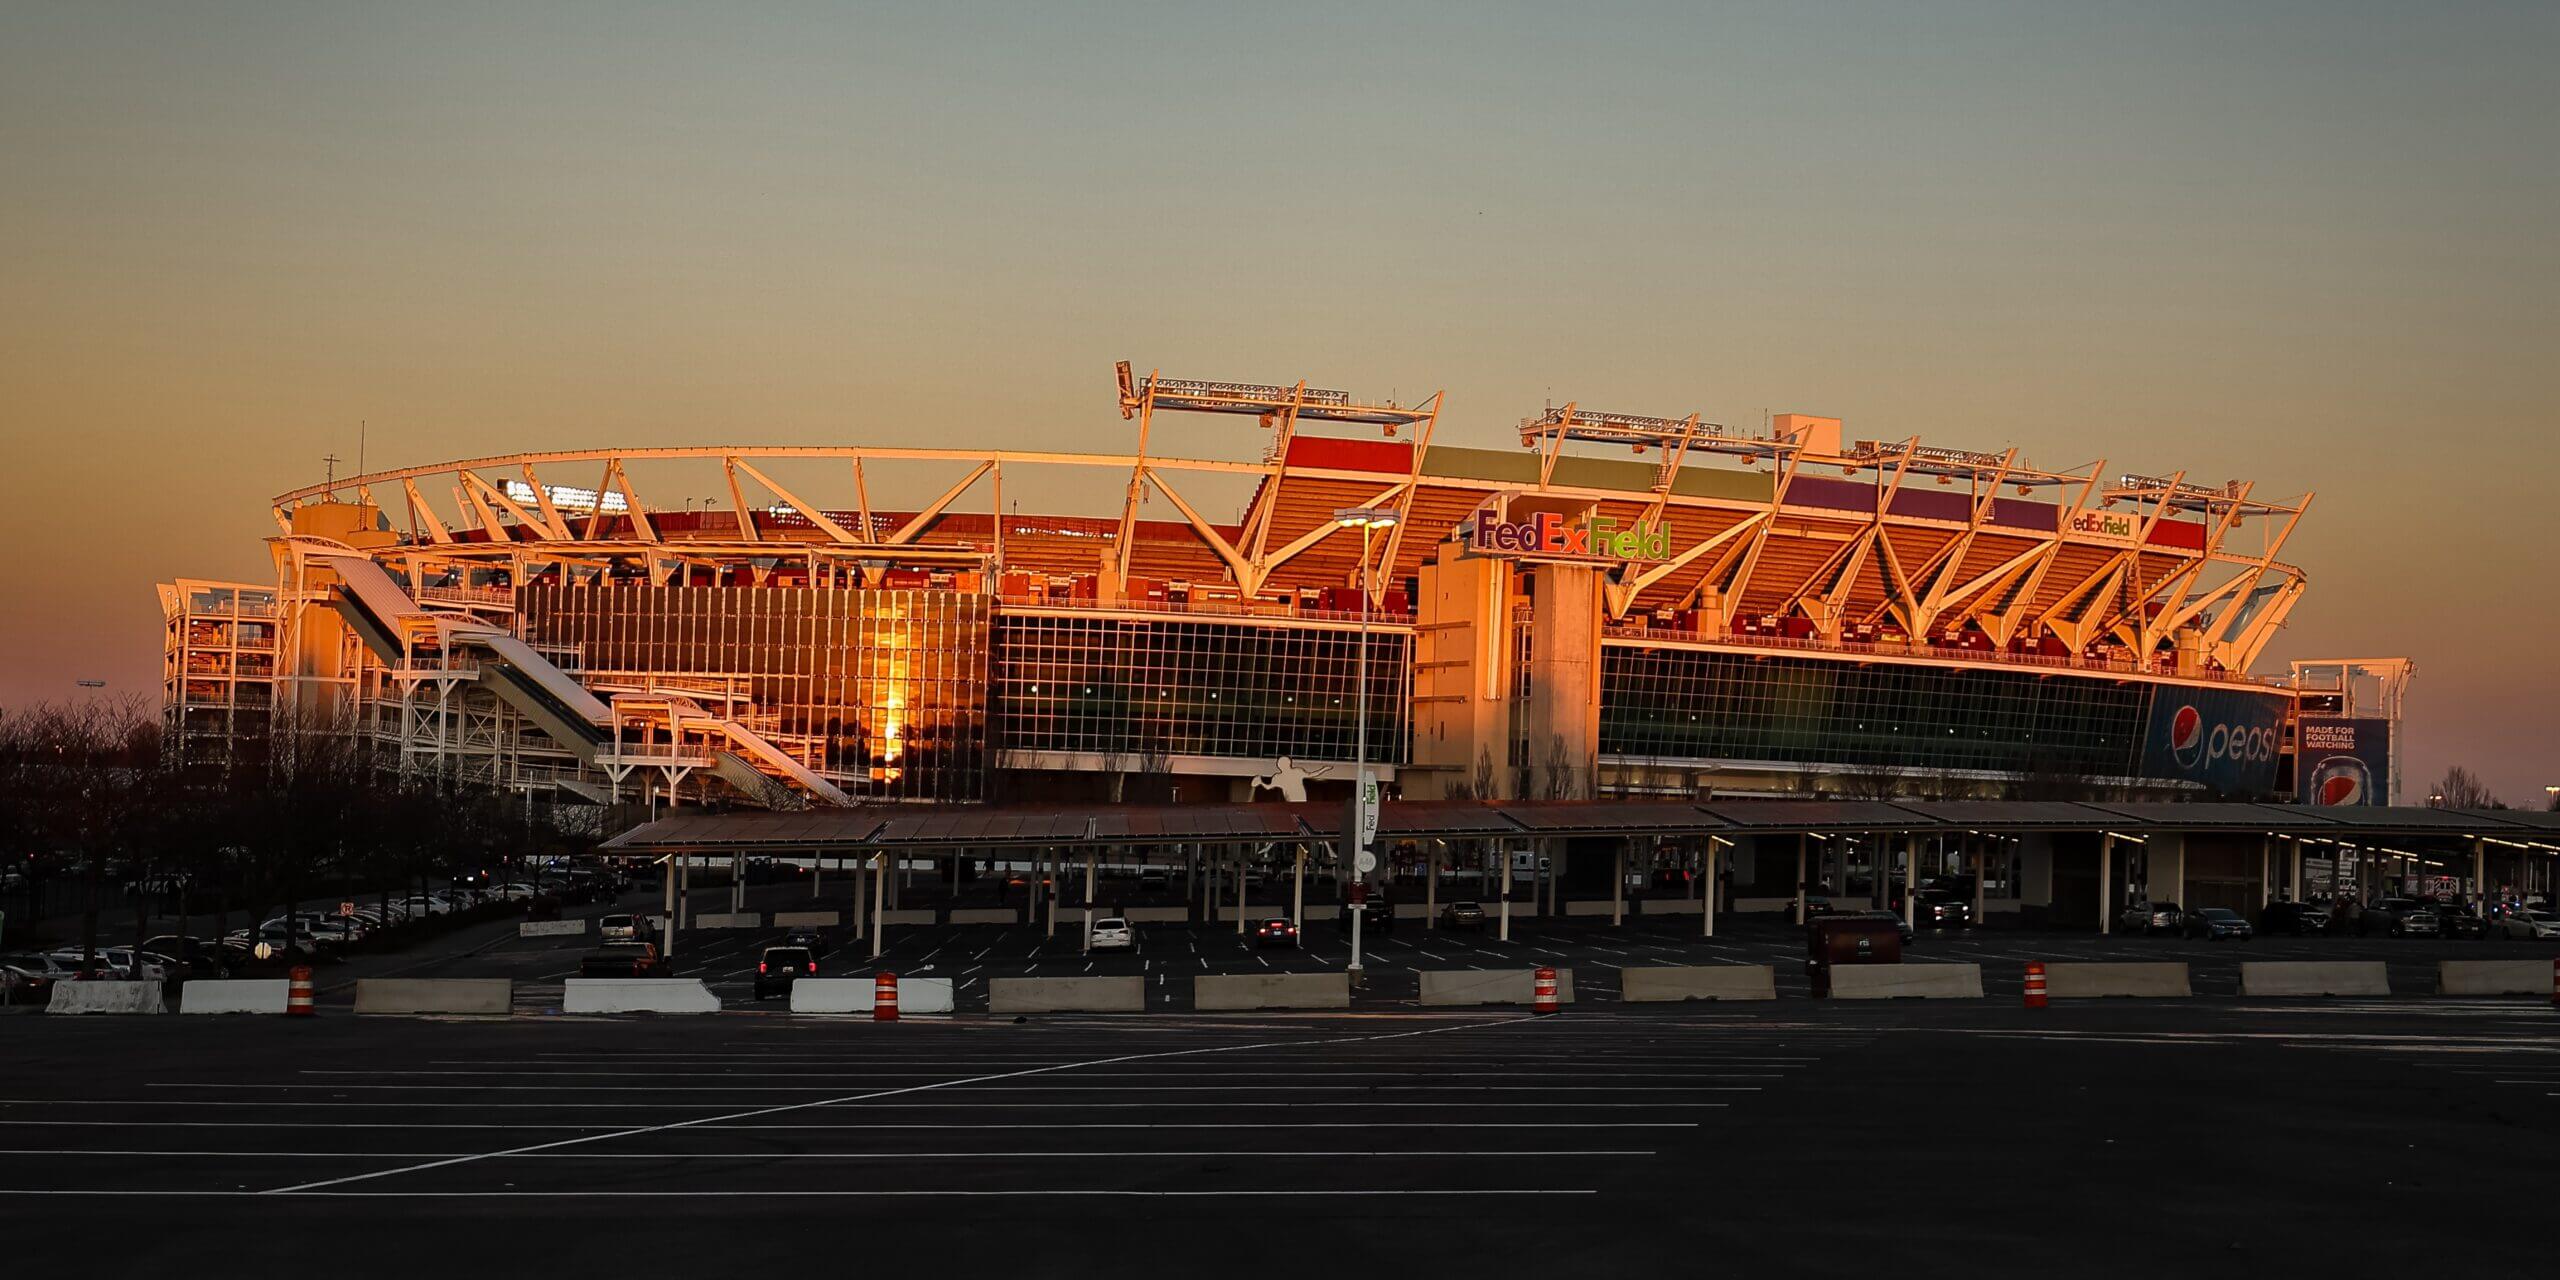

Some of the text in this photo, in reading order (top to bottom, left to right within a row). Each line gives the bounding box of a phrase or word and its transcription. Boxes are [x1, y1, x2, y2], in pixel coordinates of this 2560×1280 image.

[2070, 513, 2130, 537] edExField
[1475, 509, 1671, 560] FedExField
[2306, 726, 2355, 735] MADE FOR
[2306, 734, 2355, 742] FOOTBALL
[2205, 719, 2279, 771] pepsi
[2306, 741, 2355, 750] WATCHING
